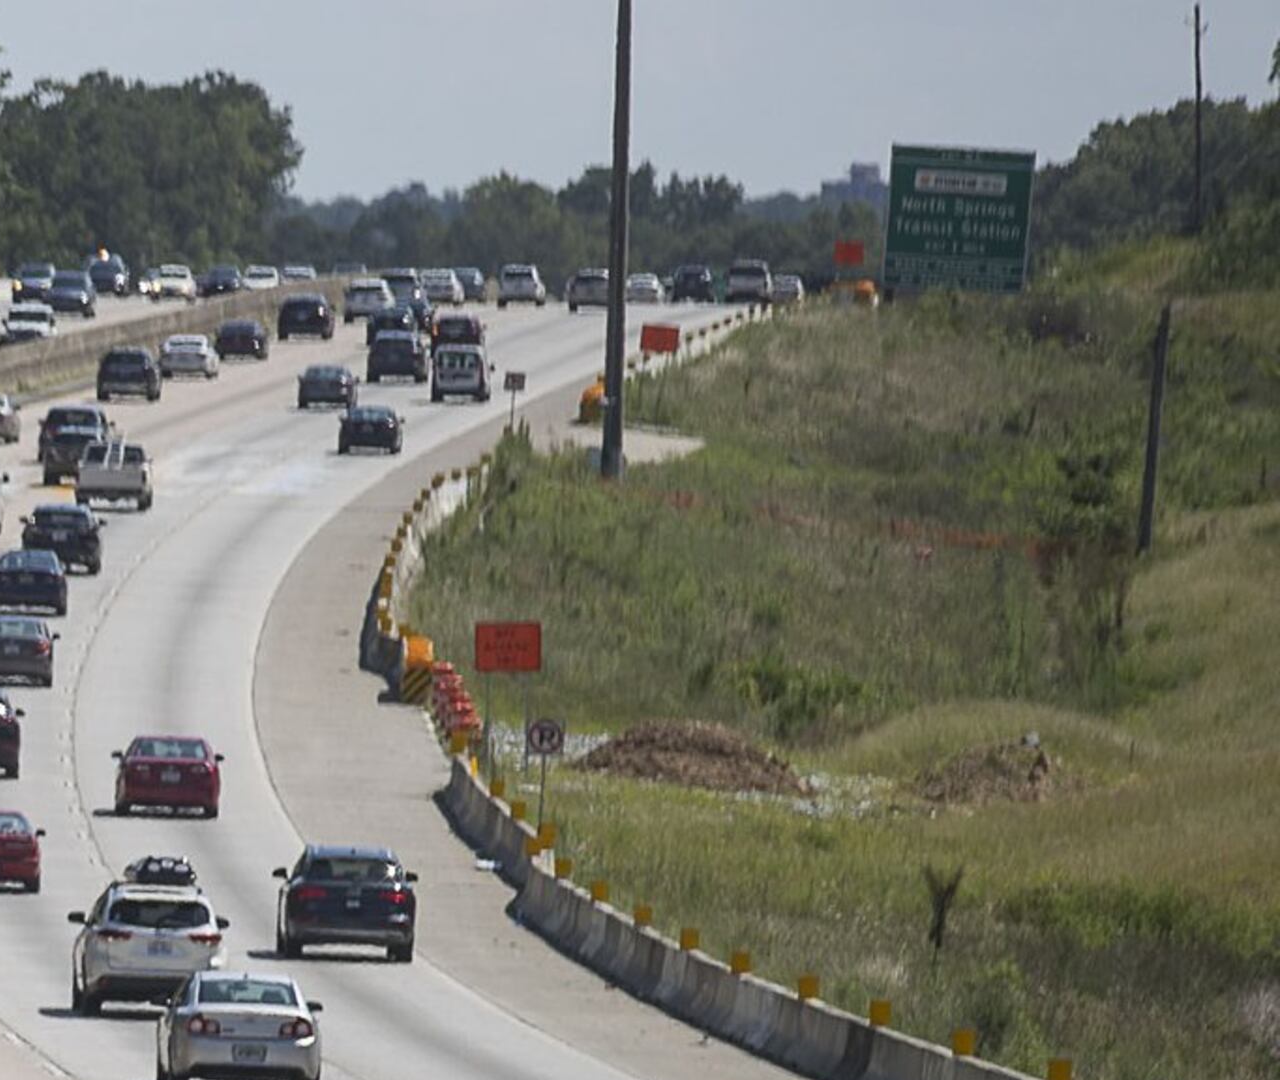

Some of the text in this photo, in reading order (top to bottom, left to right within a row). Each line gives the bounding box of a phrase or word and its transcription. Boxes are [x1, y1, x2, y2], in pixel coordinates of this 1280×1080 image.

[902, 196, 1016, 218] North Springs
[896, 216, 1021, 241] Transit Station
